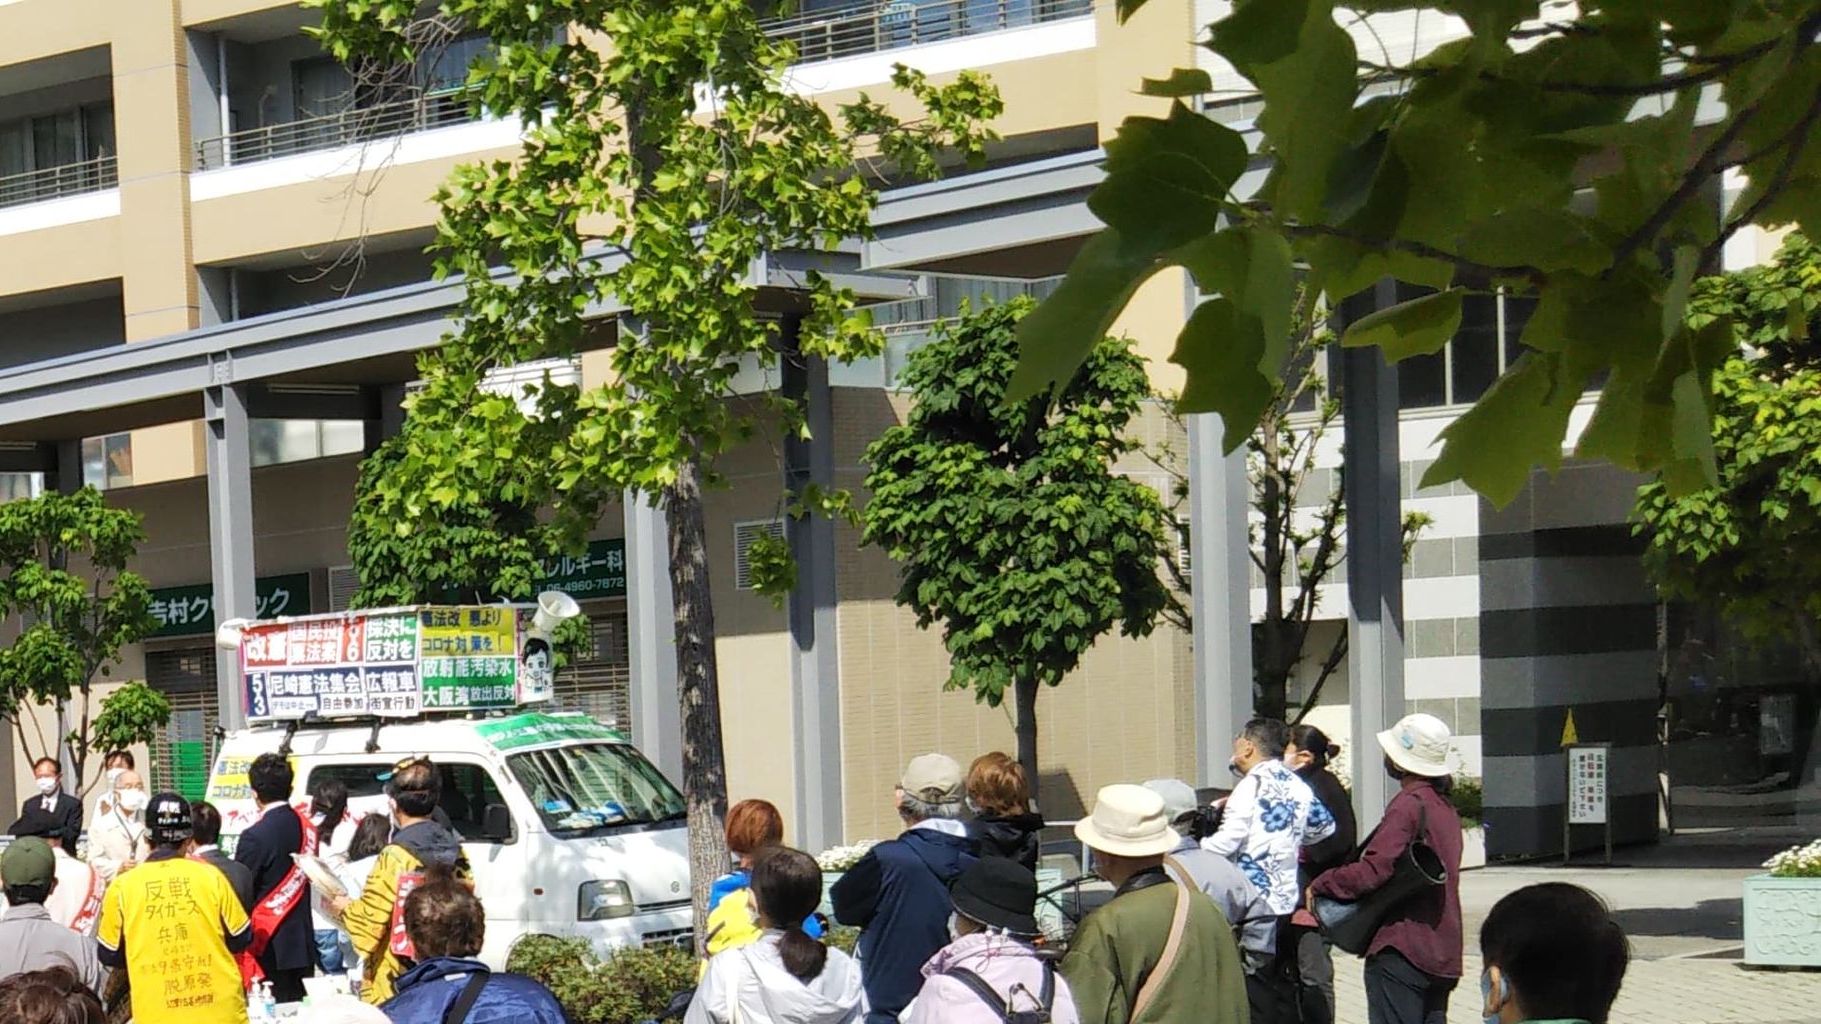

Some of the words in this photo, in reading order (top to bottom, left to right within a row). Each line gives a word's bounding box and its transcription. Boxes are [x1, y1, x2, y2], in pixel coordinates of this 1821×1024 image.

[146, 877, 193, 901] 反戦
[145, 900, 200, 920] タイガース
